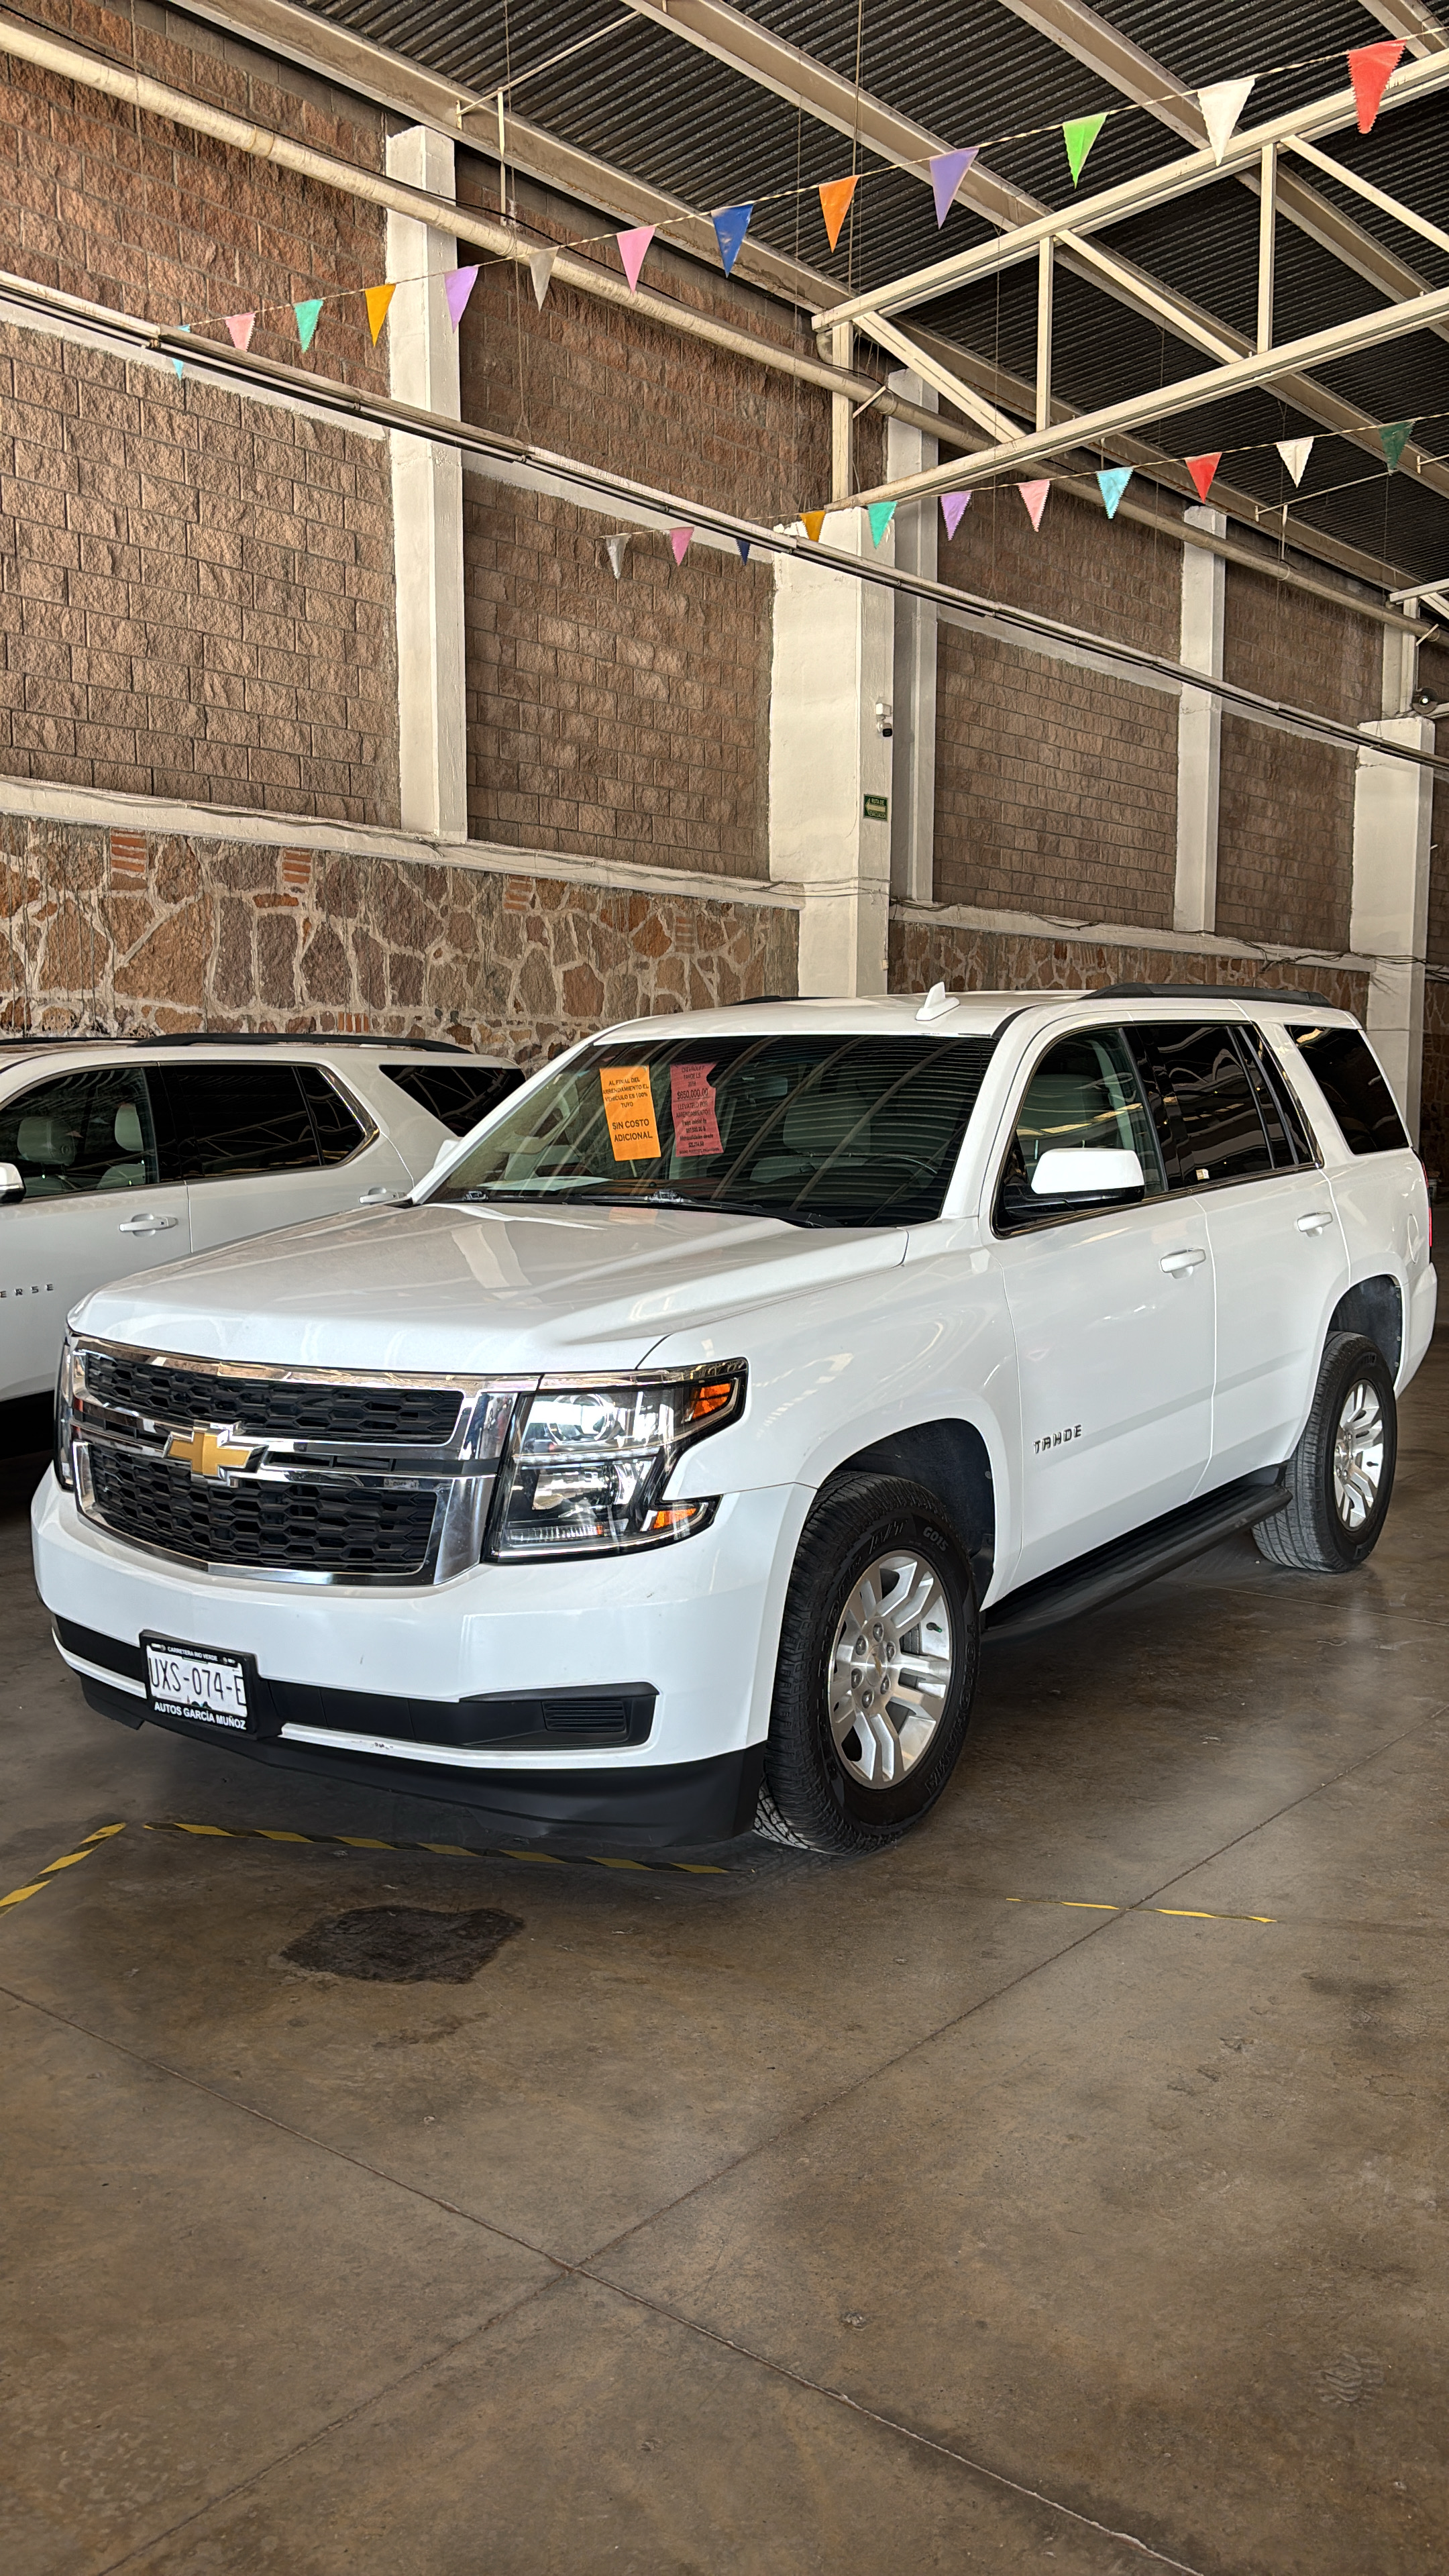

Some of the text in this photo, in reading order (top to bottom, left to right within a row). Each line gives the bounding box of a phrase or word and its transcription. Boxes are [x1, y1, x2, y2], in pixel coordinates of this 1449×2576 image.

[602, 1085, 642, 1094] ARRENDAMIENTO
[612, 1118, 649, 1130] SIN COSTO
[614, 1131, 653, 1142] ADICIONAL
[1033, 1424, 1082, 1454] TAHOE
[167, 1646, 195, 1656] CARRETERA
[154, 1701, 247, 1730] AUTOS GARCÍA MUÑOZ
